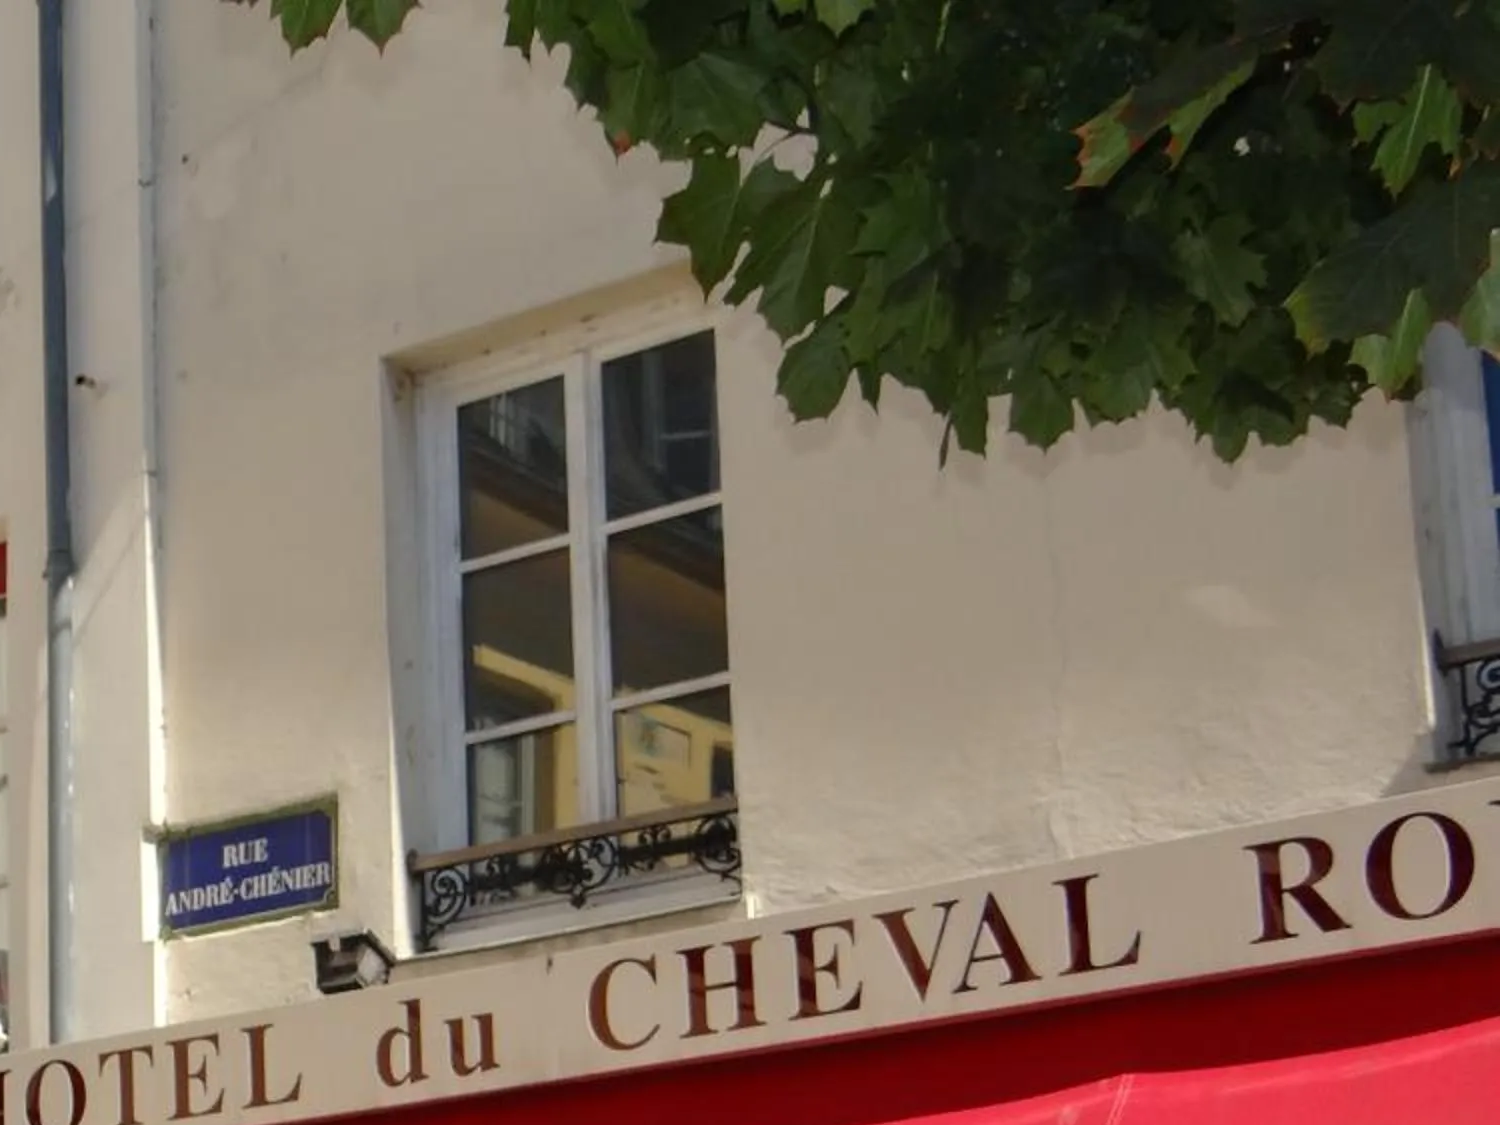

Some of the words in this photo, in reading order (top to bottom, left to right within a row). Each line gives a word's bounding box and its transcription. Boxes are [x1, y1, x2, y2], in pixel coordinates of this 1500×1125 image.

[222, 838, 269, 868] RUE
[164, 861, 331, 916] ANDRÉ-CHÉNIER
[376, 1000, 501, 1088] du
[587, 873, 1142, 1052] CHEVAL
[1242, 800, 1500, 945] RO
